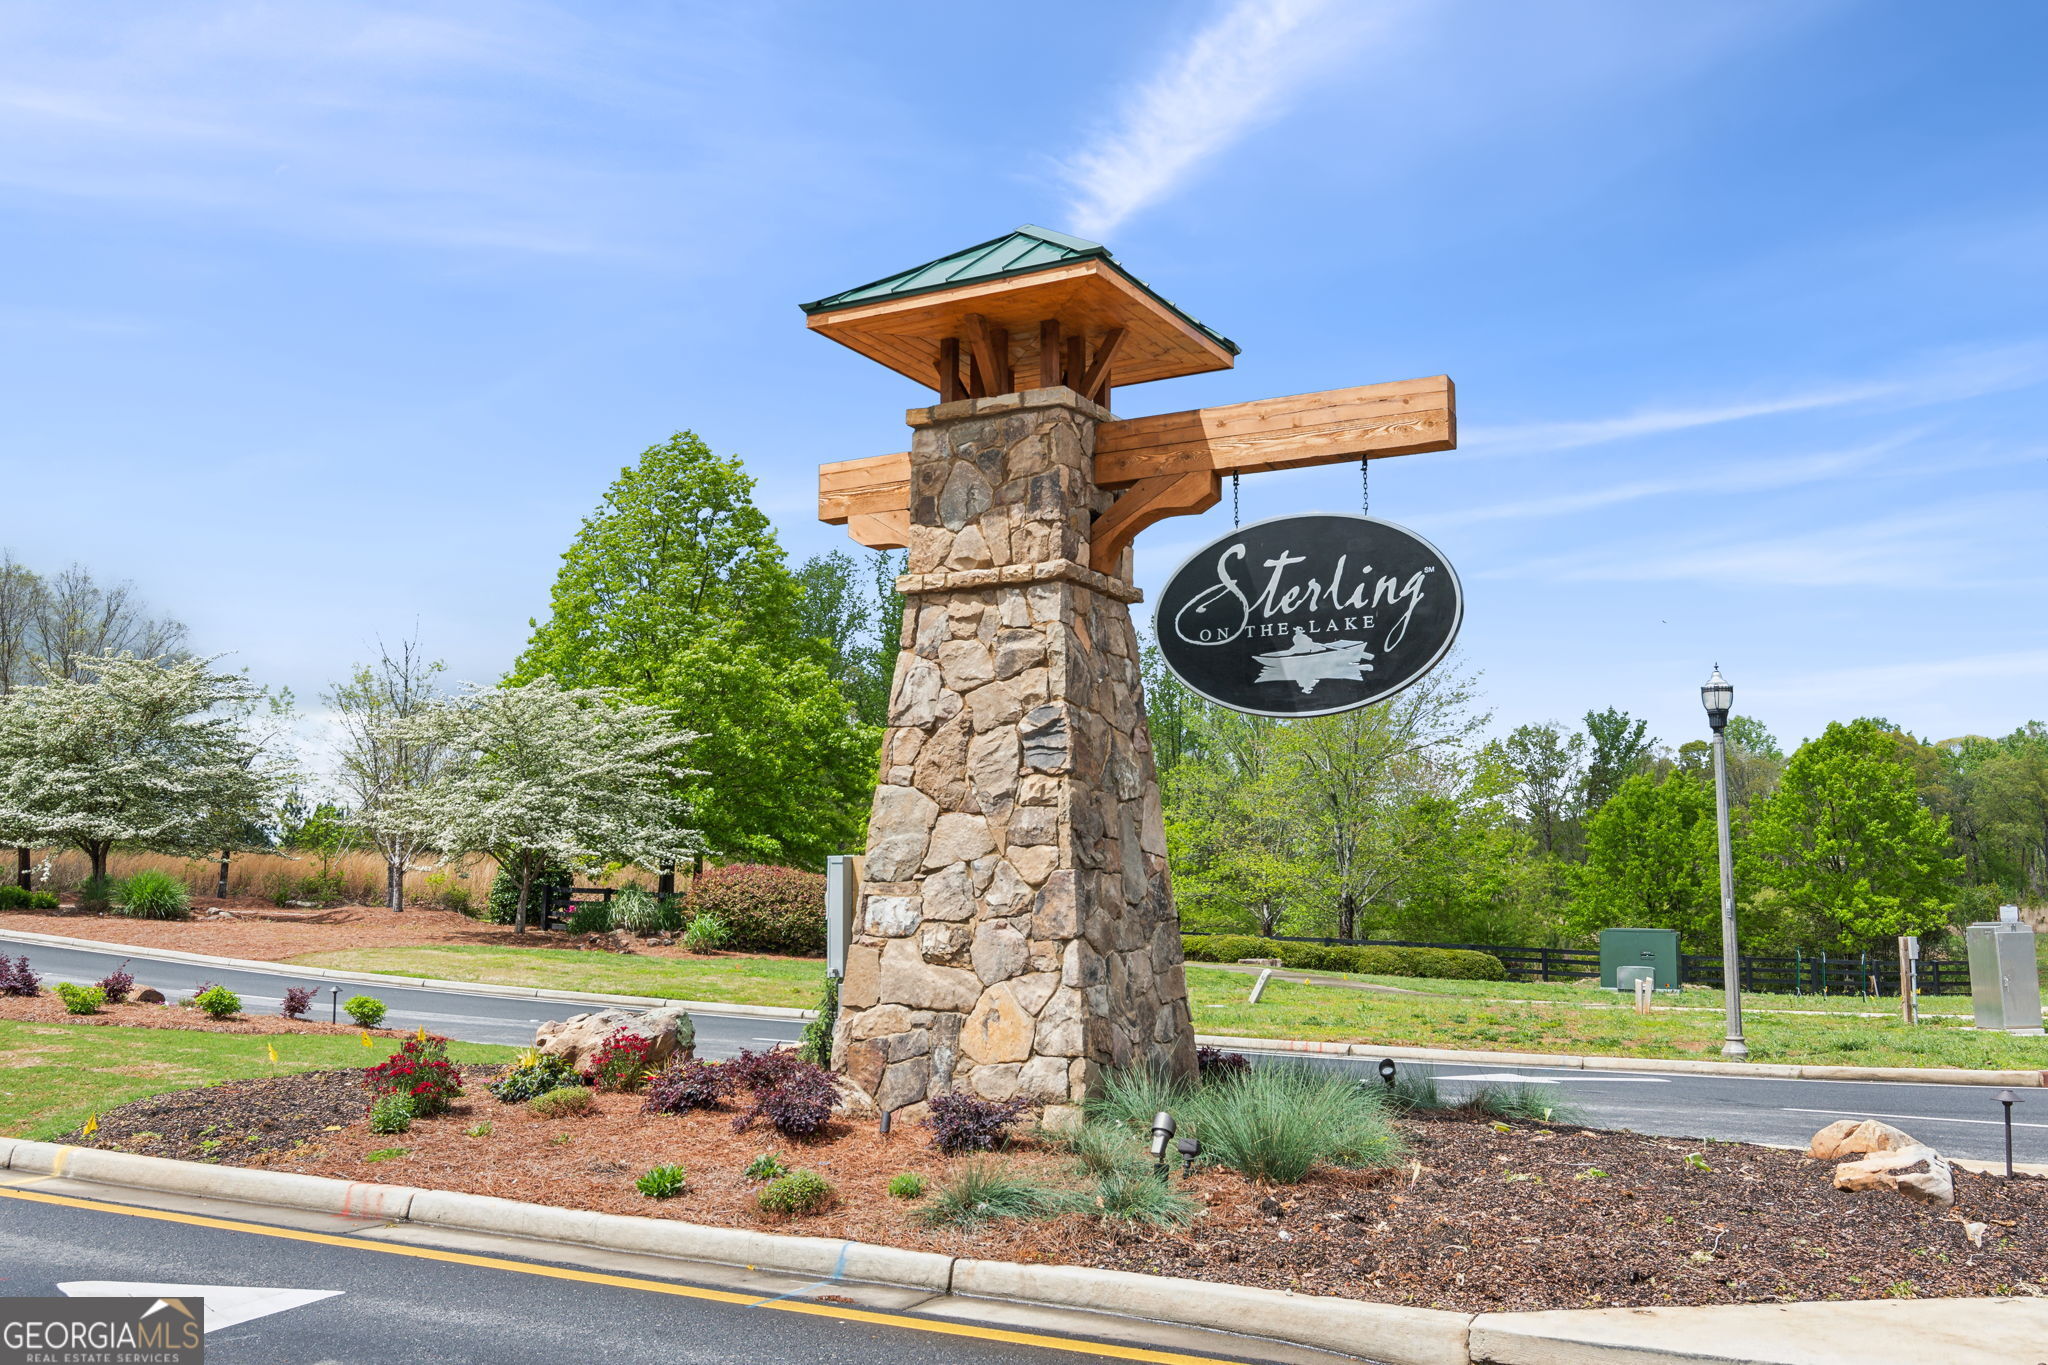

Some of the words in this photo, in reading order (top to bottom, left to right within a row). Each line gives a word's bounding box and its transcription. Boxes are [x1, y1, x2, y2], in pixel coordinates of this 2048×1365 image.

[1175, 543, 1426, 653] Sterling
[1199, 627, 1229, 642] ON
[1244, 622, 1289, 639] THE
[1308, 615, 1376, 634] LAKE
